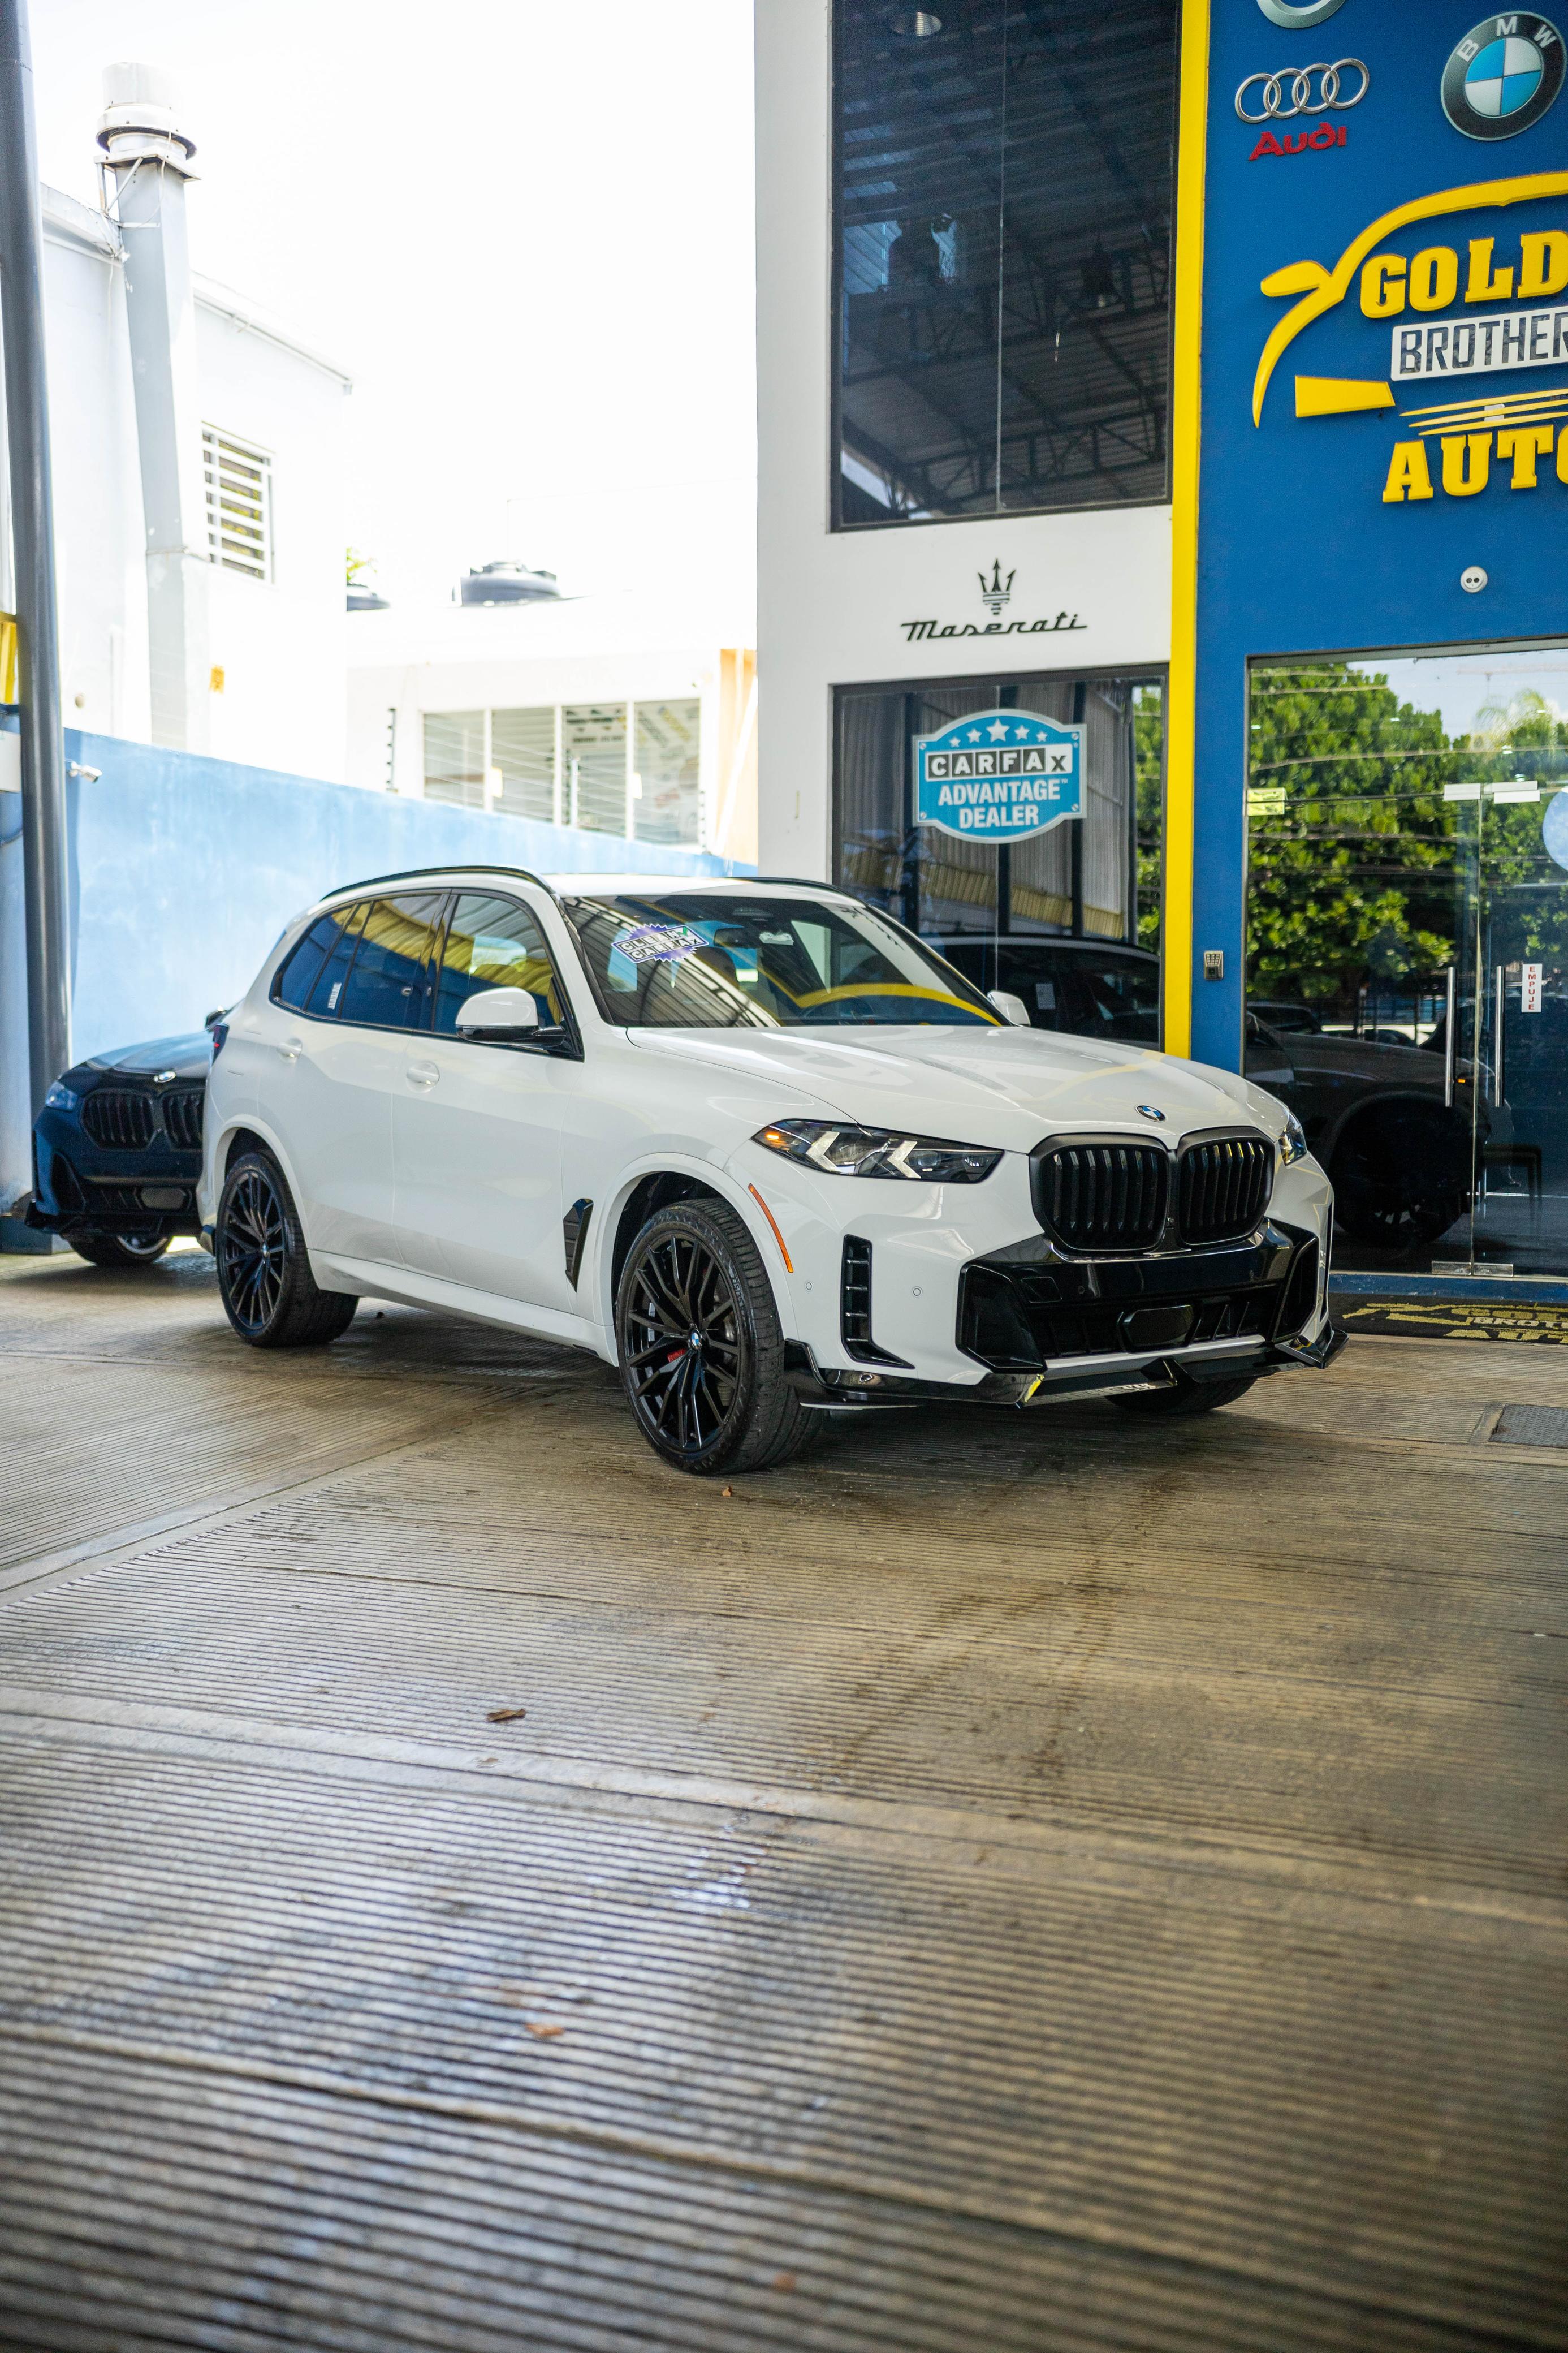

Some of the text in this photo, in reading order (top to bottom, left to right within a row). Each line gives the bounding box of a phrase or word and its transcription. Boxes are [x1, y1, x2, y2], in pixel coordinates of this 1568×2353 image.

[1457, 16, 1557, 62] BMW
[1249, 122, 1347, 161] Audi
[1360, 230, 1568, 318] GOLD
[1383, 424, 1568, 503] AUT
[901, 611, 1087, 641] Maserati
[930, 750, 1067, 777] CARFAX
[959, 805, 1039, 829] DEALER
[621, 930, 680, 951] CLEAN
[630, 938, 701, 959] CARFAX
